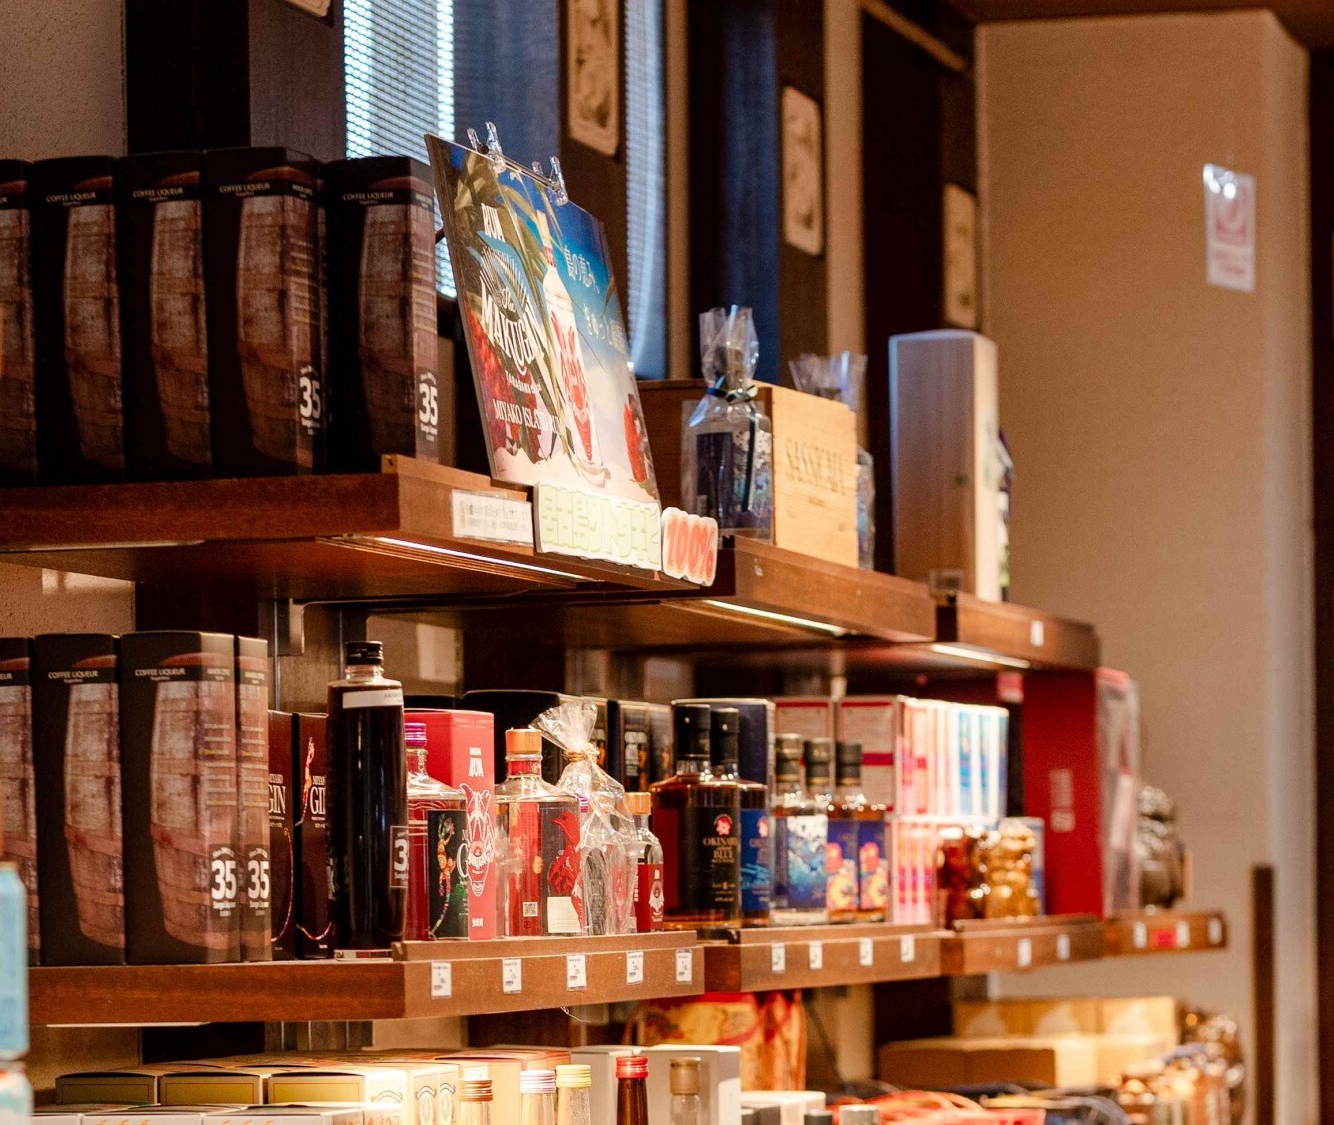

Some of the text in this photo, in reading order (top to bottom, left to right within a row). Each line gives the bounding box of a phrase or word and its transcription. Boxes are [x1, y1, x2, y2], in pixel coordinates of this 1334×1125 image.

[46, 192, 97, 203] COFFEE LIQUEUR
[133, 187, 184, 198] COFFEE LIQUEUR
[219, 182, 271, 194] COFFEE LIQUEUR
[366, 191, 394, 199] LIQUEUR
[481, 202, 506, 243] RUM
[299, 376, 322, 420] 35
[419, 382, 439, 426] 35
[492, 398, 522, 425] MIYAKO
[666, 511, 716, 584] 100%
[47, 670, 98, 679] COFFEE LIQUEUR
[134, 667, 186, 677] COFFEE LIQUEUR
[211, 859, 237, 901] 35
[247, 859, 270, 900] 35
